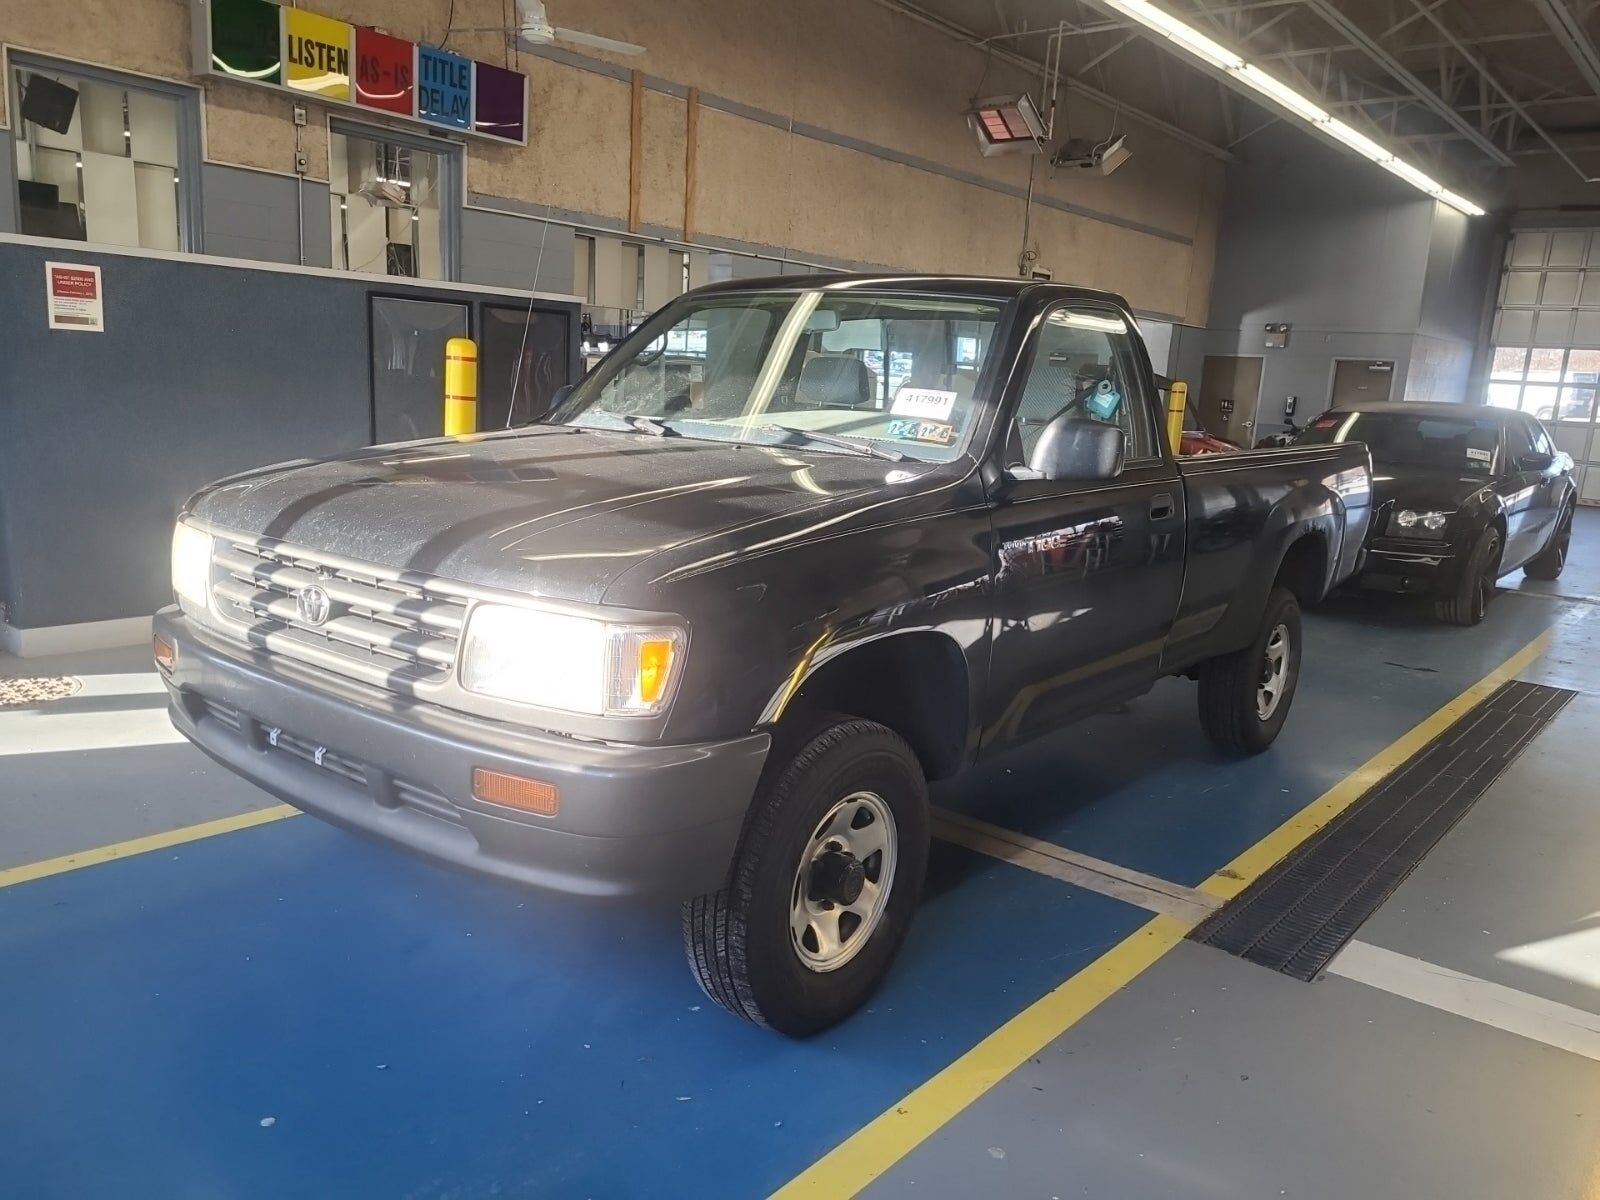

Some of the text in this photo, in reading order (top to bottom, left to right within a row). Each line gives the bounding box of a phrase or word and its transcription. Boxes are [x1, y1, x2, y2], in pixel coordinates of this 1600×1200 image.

[288, 34, 349, 77] LISTEN
[422, 53, 467, 91] TITLE
[419, 85, 468, 120] DELAY
[905, 394, 949, 406] 417991
